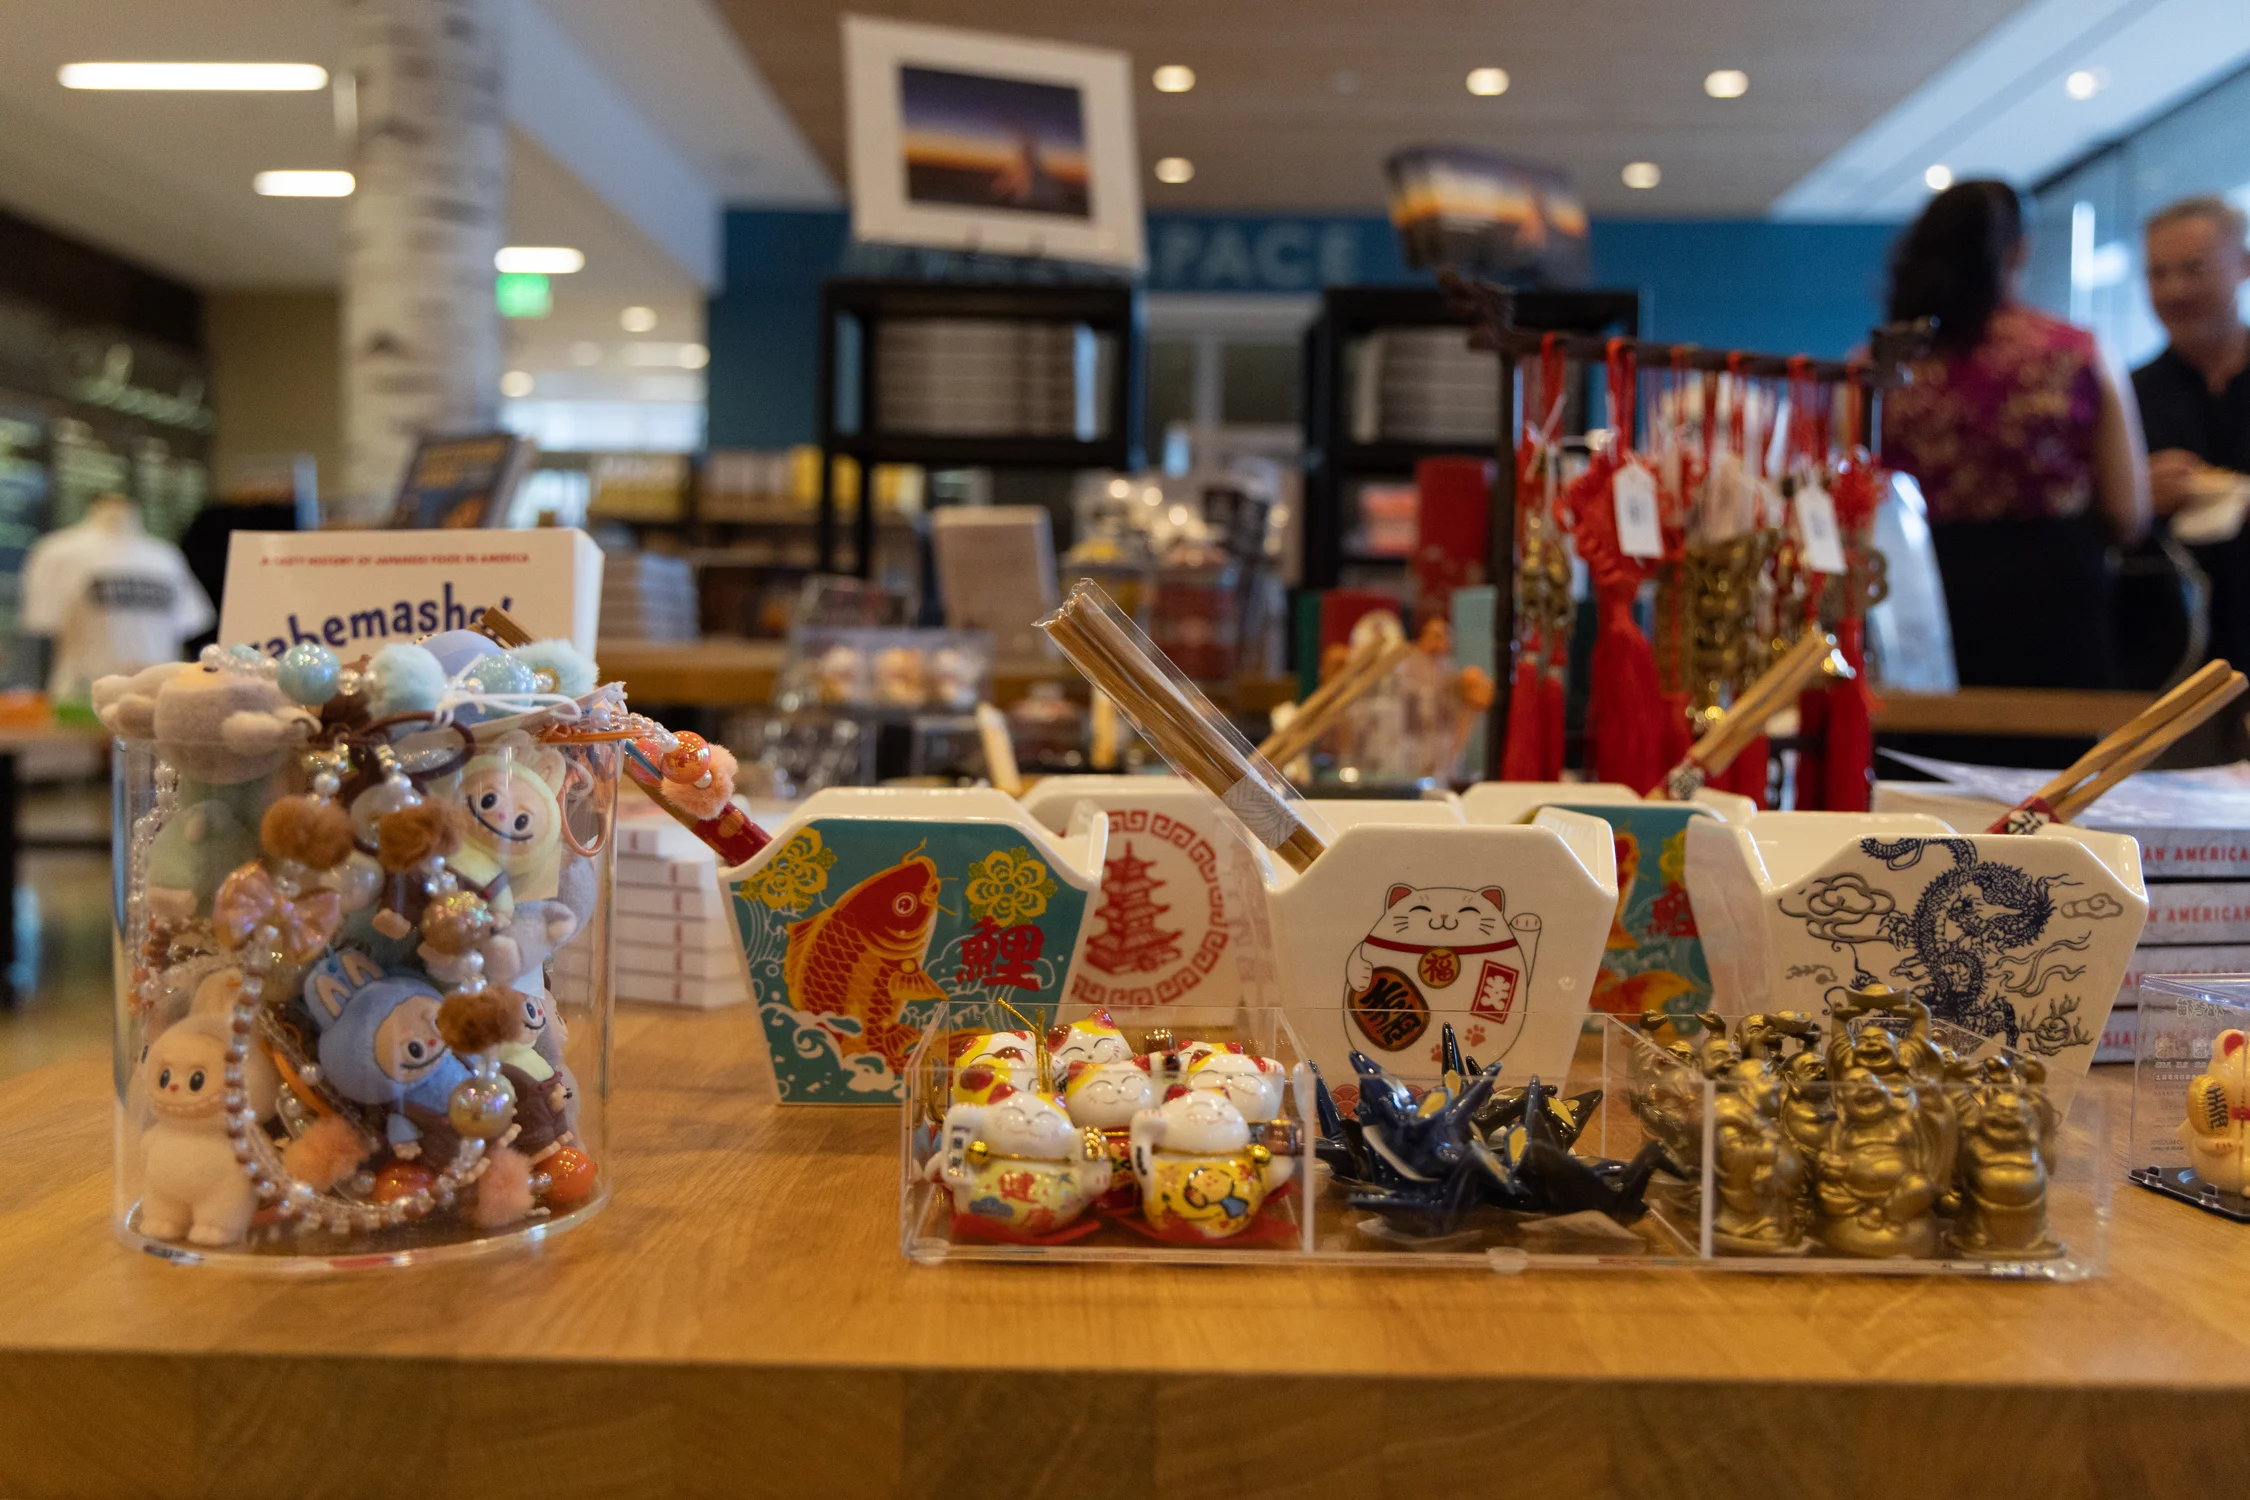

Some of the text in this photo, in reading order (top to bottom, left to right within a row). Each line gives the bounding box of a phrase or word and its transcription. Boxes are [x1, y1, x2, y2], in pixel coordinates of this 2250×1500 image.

[308, 554, 355, 567] HISTORY
[358, 554, 373, 567] OF
[376, 553, 427, 566] JAPANESE
[431, 552, 461, 566] FOOD
[465, 552, 477, 565] IN
[480, 551, 529, 565] AMERICA
[956, 915, 1045, 992] 鯉
[1422, 952, 1455, 983] 福
